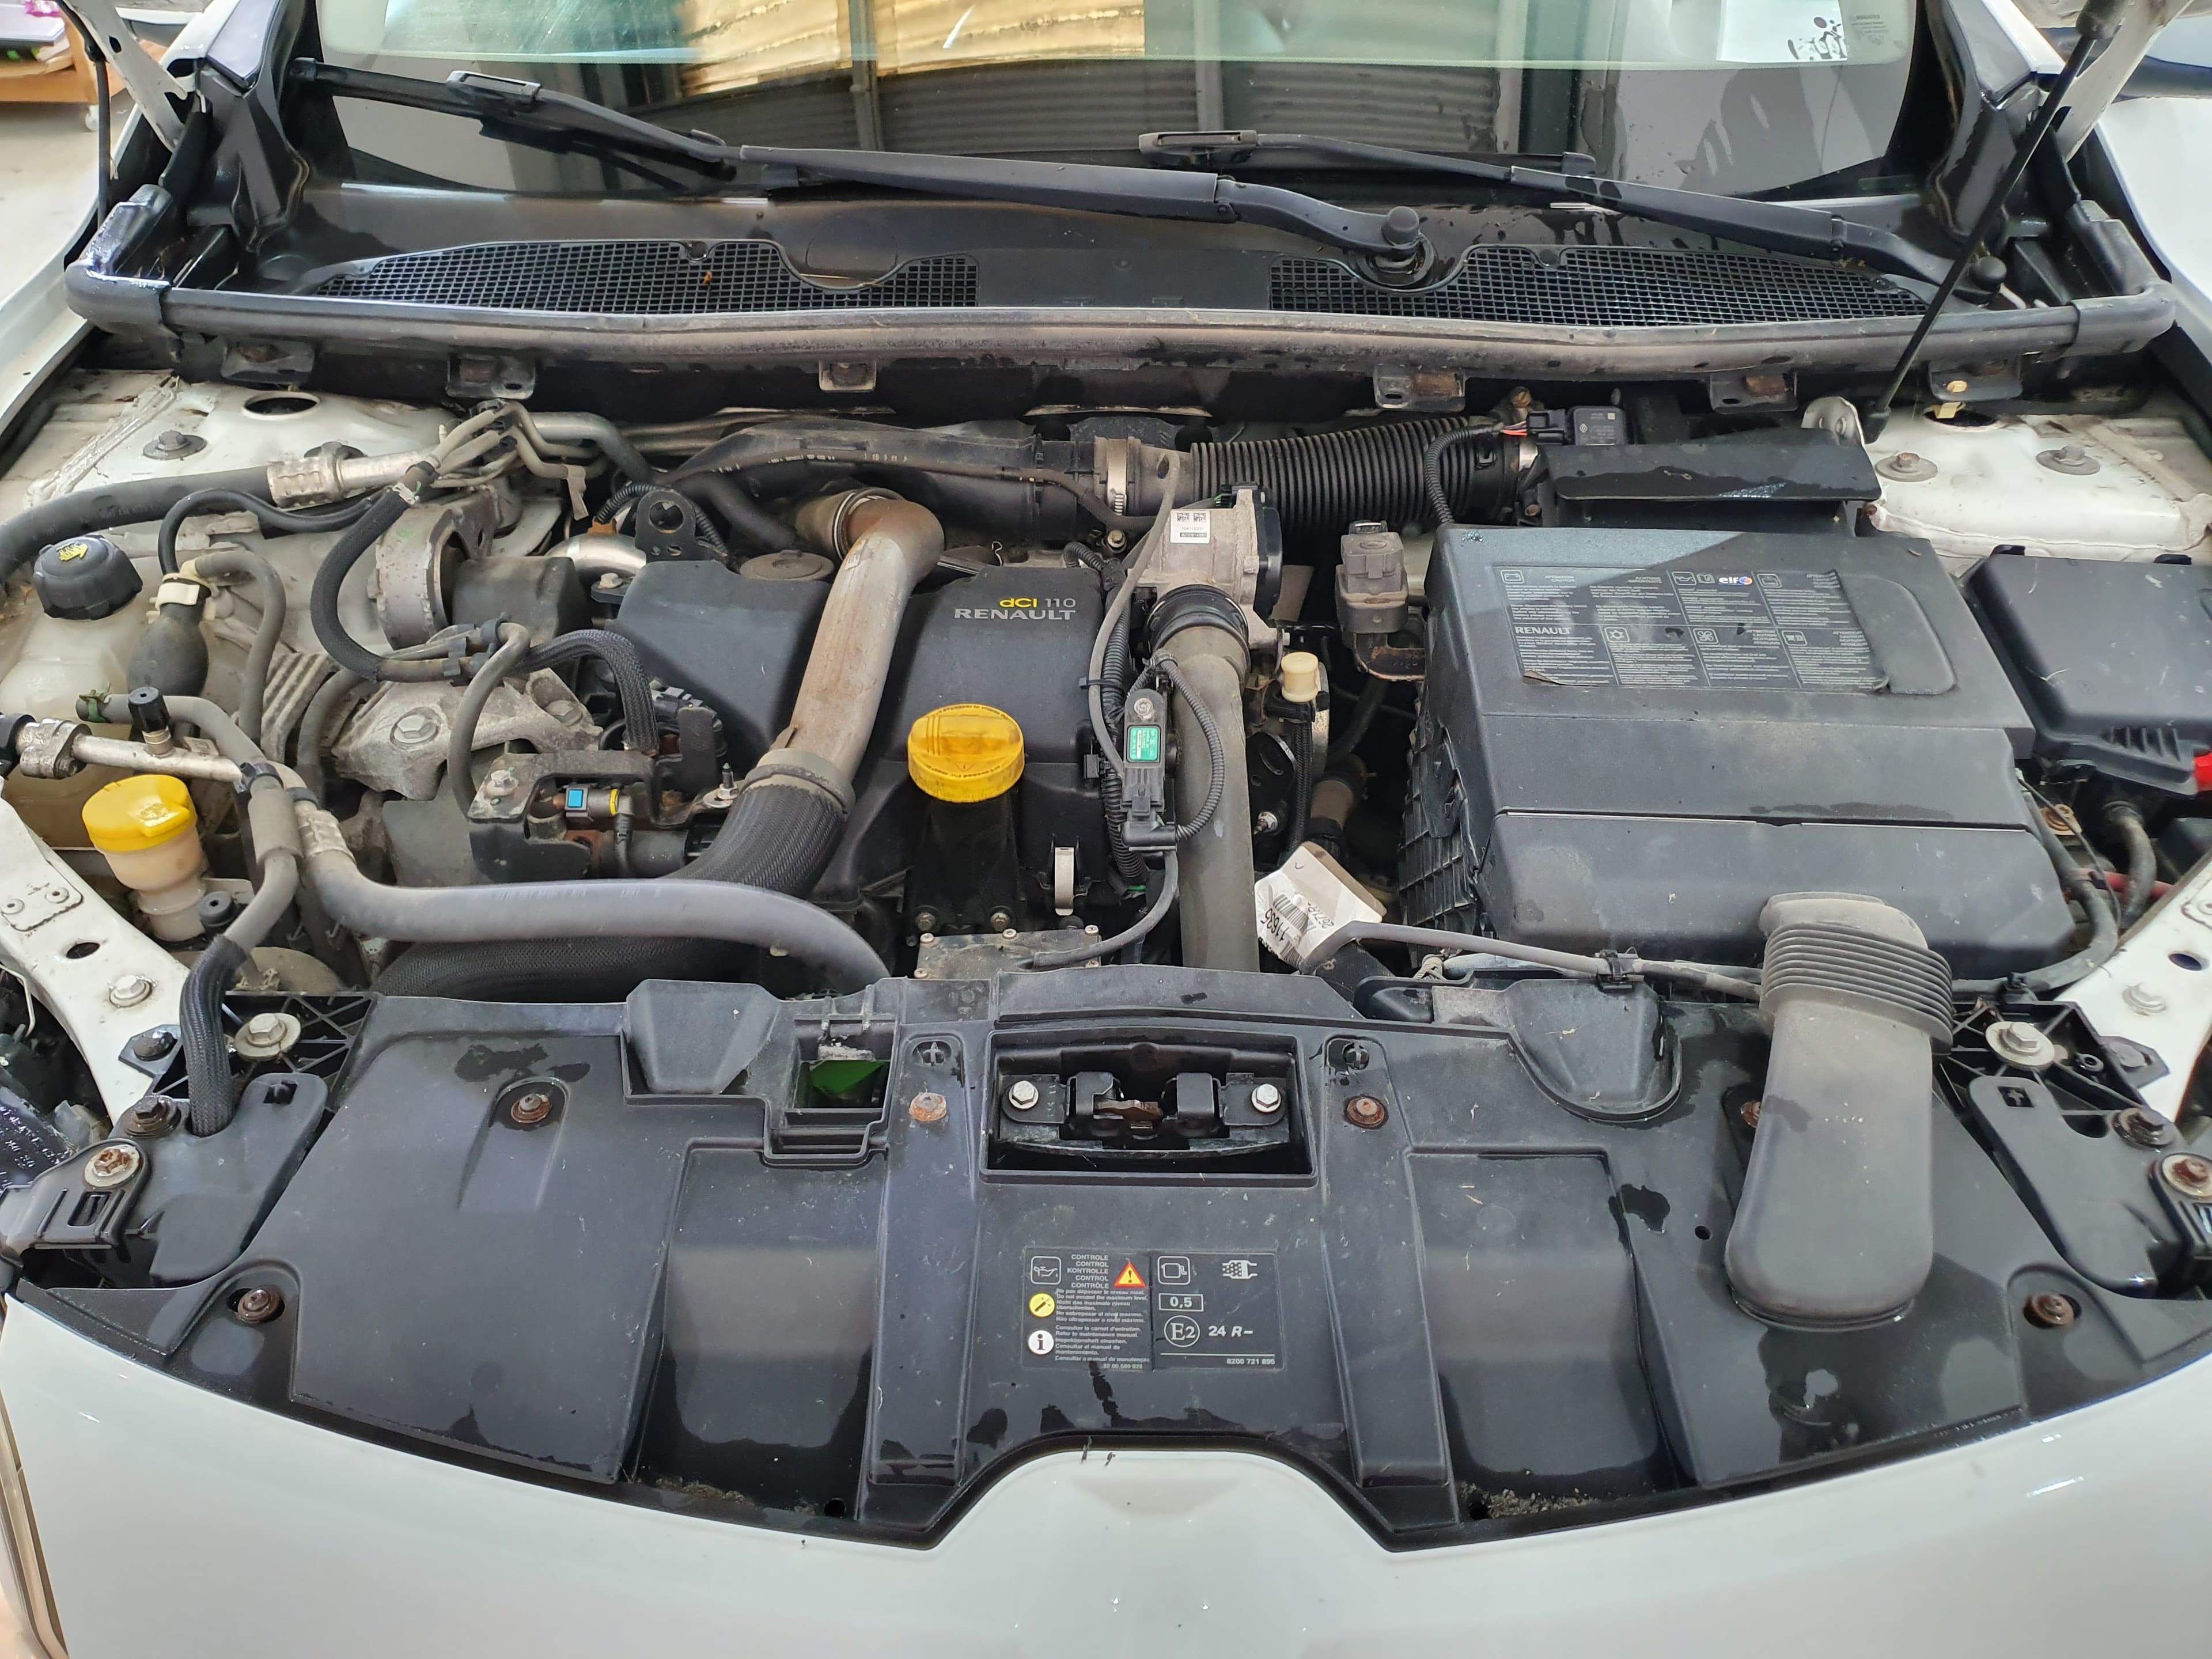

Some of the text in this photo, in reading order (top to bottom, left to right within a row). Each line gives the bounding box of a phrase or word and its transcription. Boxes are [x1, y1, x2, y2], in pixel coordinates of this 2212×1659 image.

[1045, 598, 1076, 608] 110
[954, 608, 1076, 620] RENAULT
[1260, 908, 1290, 942] 11635
[1170, 1297, 1192, 1309] 0,5
[1171, 1323, 1196, 1340] E2
[1209, 1325, 1226, 1336] 24
